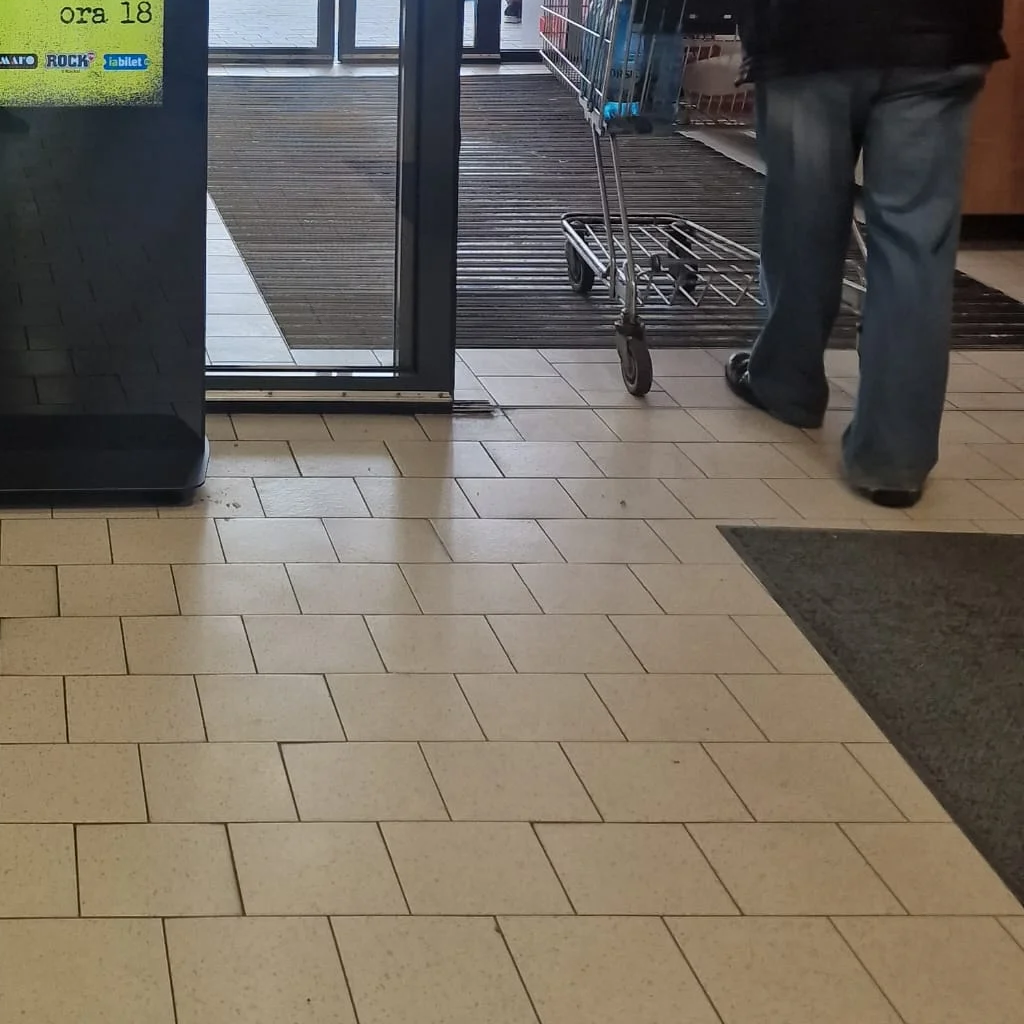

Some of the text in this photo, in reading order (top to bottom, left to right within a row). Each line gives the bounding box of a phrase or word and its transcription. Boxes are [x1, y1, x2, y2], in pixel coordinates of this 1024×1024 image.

[61, 1, 152, 24] ora 18
[46, 54, 89, 67] ROCK
[109, 56, 142, 67] iabilet
